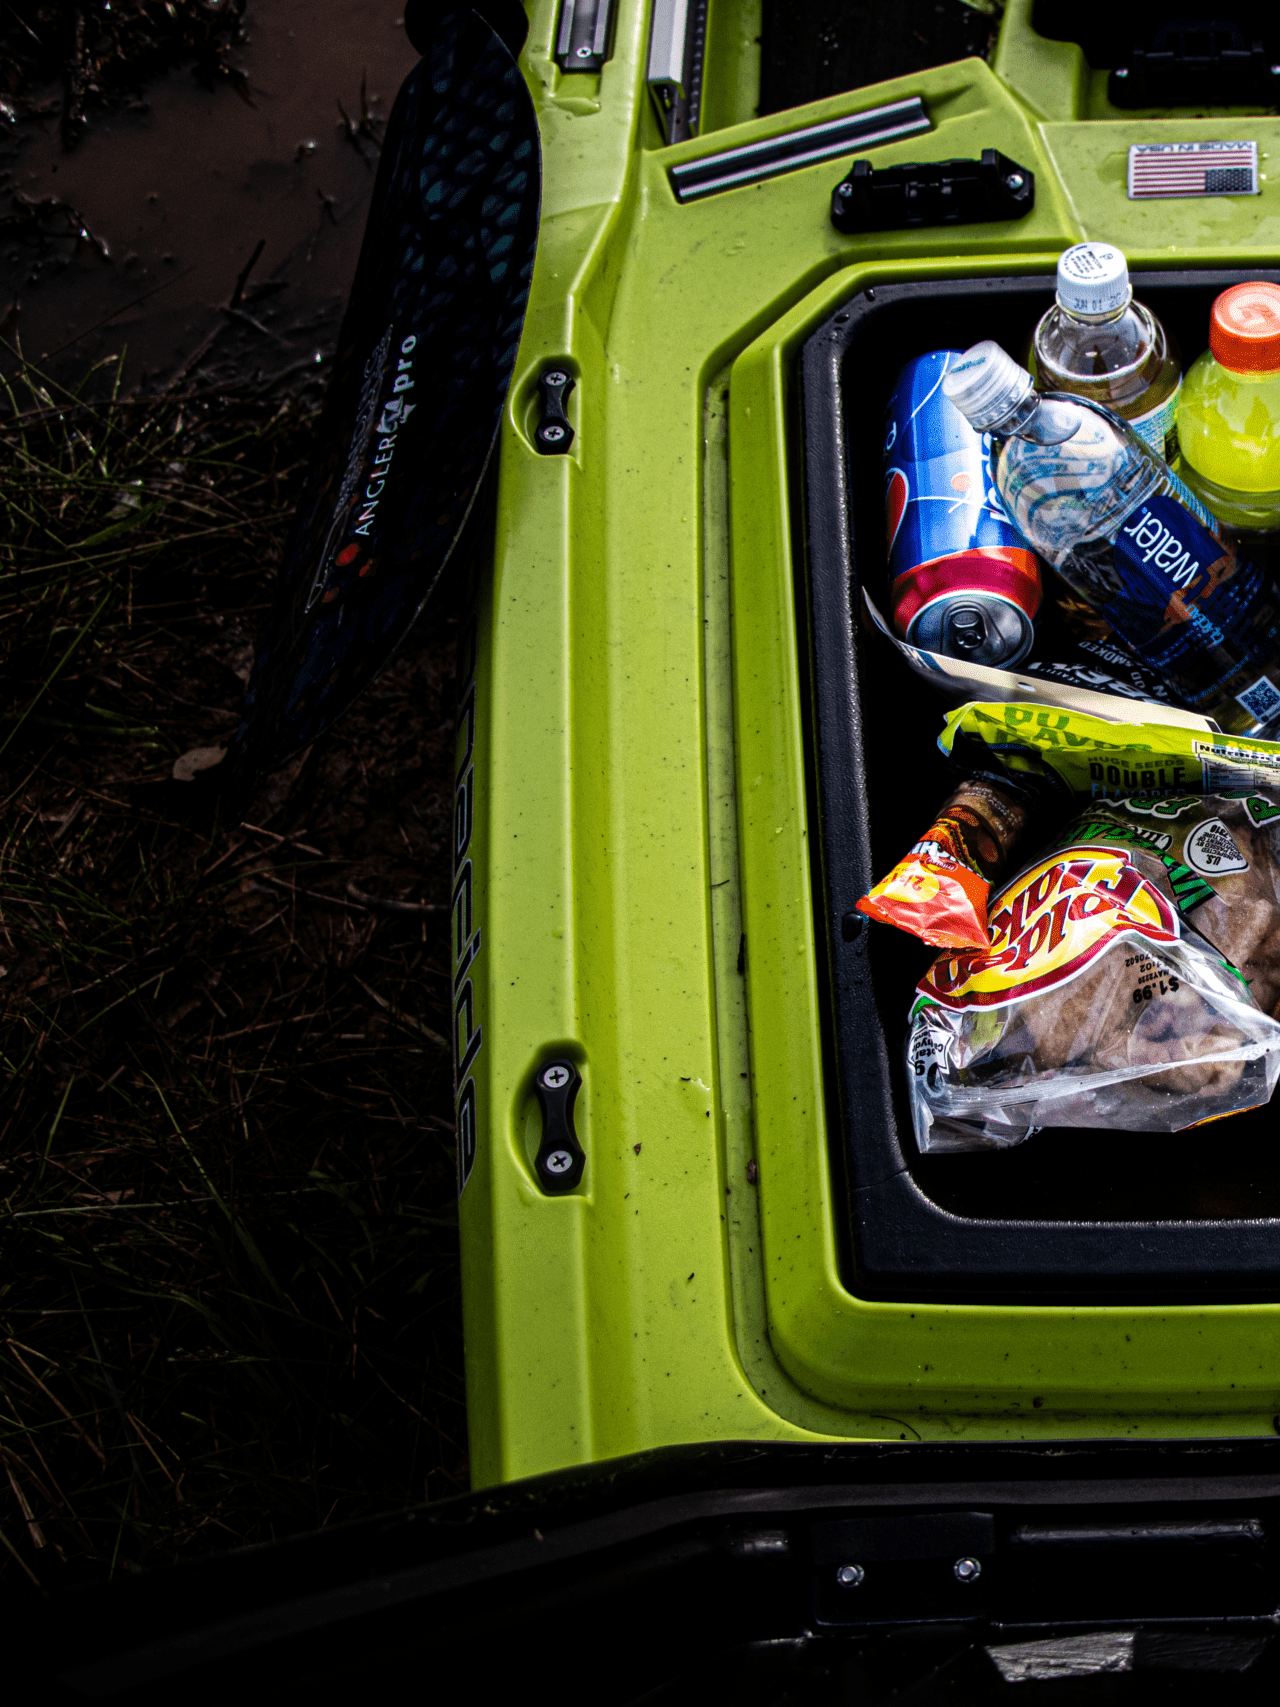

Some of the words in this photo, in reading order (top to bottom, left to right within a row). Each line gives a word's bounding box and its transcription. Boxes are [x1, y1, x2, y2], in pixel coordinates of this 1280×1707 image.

[1136, 142, 1173, 152] USA
[1178, 143, 1193, 151] IN
[1199, 141, 1252, 151] MADE
[1073, 296, 1088, 309] JUN
[354, 433, 398, 536] ANGLER
[392, 334, 417, 393] pro
[1087, 756, 1129, 767] HUGE
[1134, 758, 1184, 769] SEEDS
[1089, 763, 1184, 788] DOUBLE
[1205, 853, 1222, 867] U.S.
[988, 860, 1142, 946] Flak
[1132, 976, 1180, 1004] $1.99
